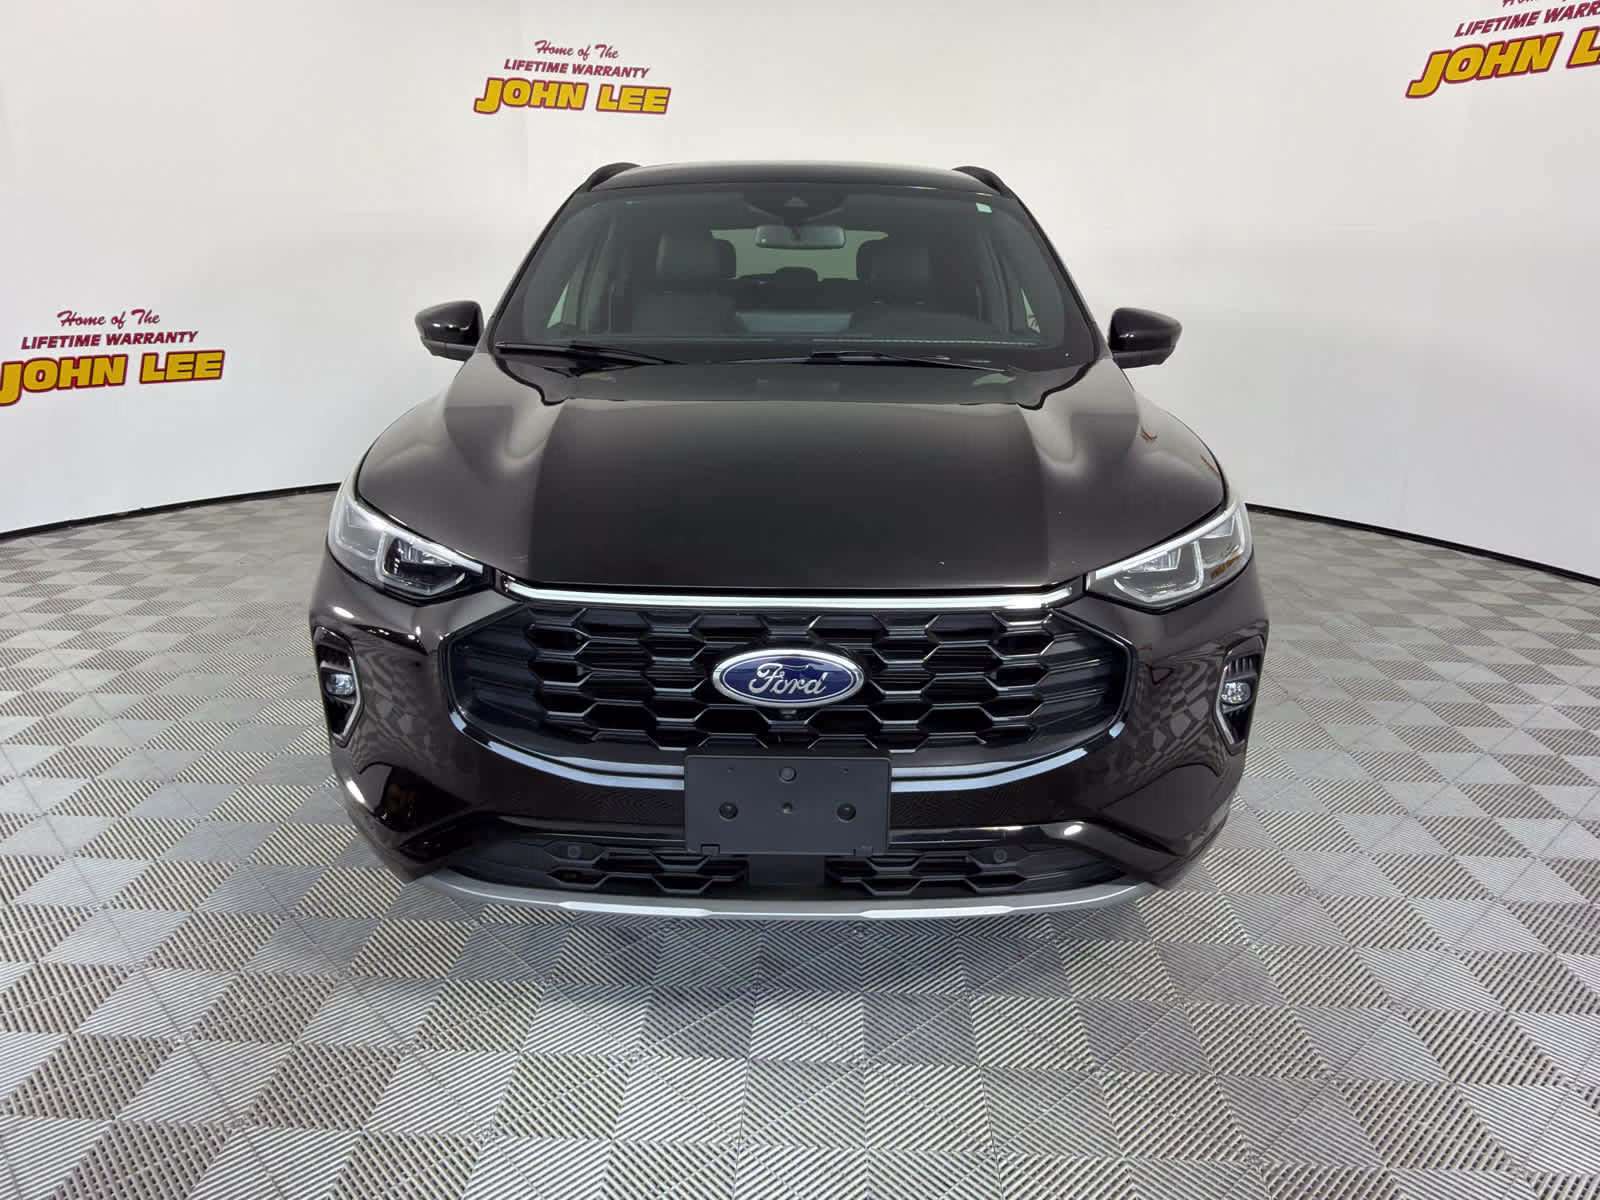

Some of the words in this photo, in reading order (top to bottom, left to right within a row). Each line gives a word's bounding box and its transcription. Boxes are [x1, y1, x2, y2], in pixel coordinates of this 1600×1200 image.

[1454, 10, 1541, 37] LIFETIME
[534, 40, 574, 55] Home
[577, 46, 590, 60] of
[594, 44, 619, 59] The
[504, 59, 569, 74] LIFETIME
[571, 63, 650, 78] WARRANTY
[1405, 31, 1564, 98] JOHN
[474, 77, 589, 114] JOHN
[596, 84, 671, 114] LEE
[57, 310, 106, 328] Home
[111, 311, 126, 329] of
[131, 308, 160, 325] The
[21, 334, 101, 350] LIFETIME
[106, 331, 198, 346] WARRANTY
[0, 354, 129, 407] JOHN
[139, 350, 225, 384] LEE
[748, 663, 829, 695] Ford
